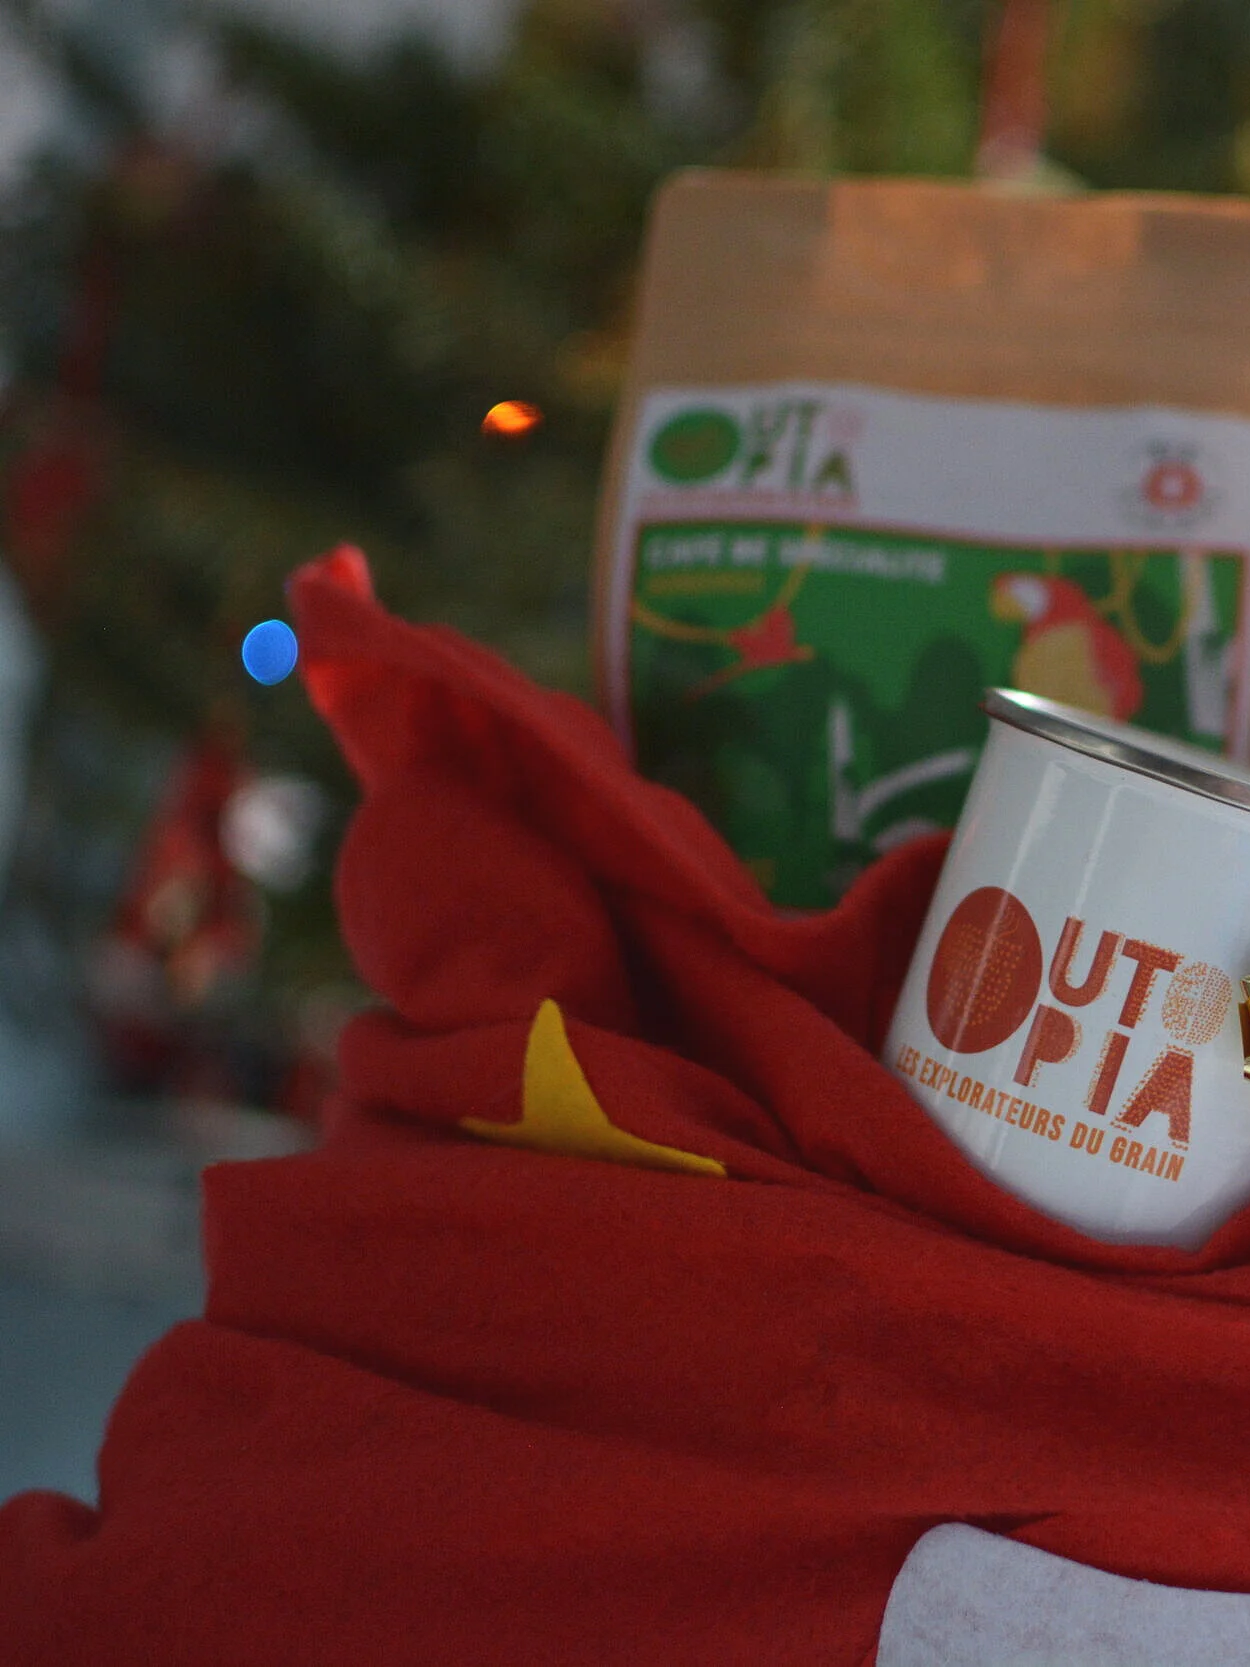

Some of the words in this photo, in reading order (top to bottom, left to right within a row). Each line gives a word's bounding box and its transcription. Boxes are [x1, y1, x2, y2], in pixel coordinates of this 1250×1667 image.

[896, 1043, 919, 1075] LES
[916, 1057, 1067, 1142] EXPLORATEURS
[1069, 1121, 1105, 1155] DU
[1109, 1136, 1185, 1182] GRAIN
